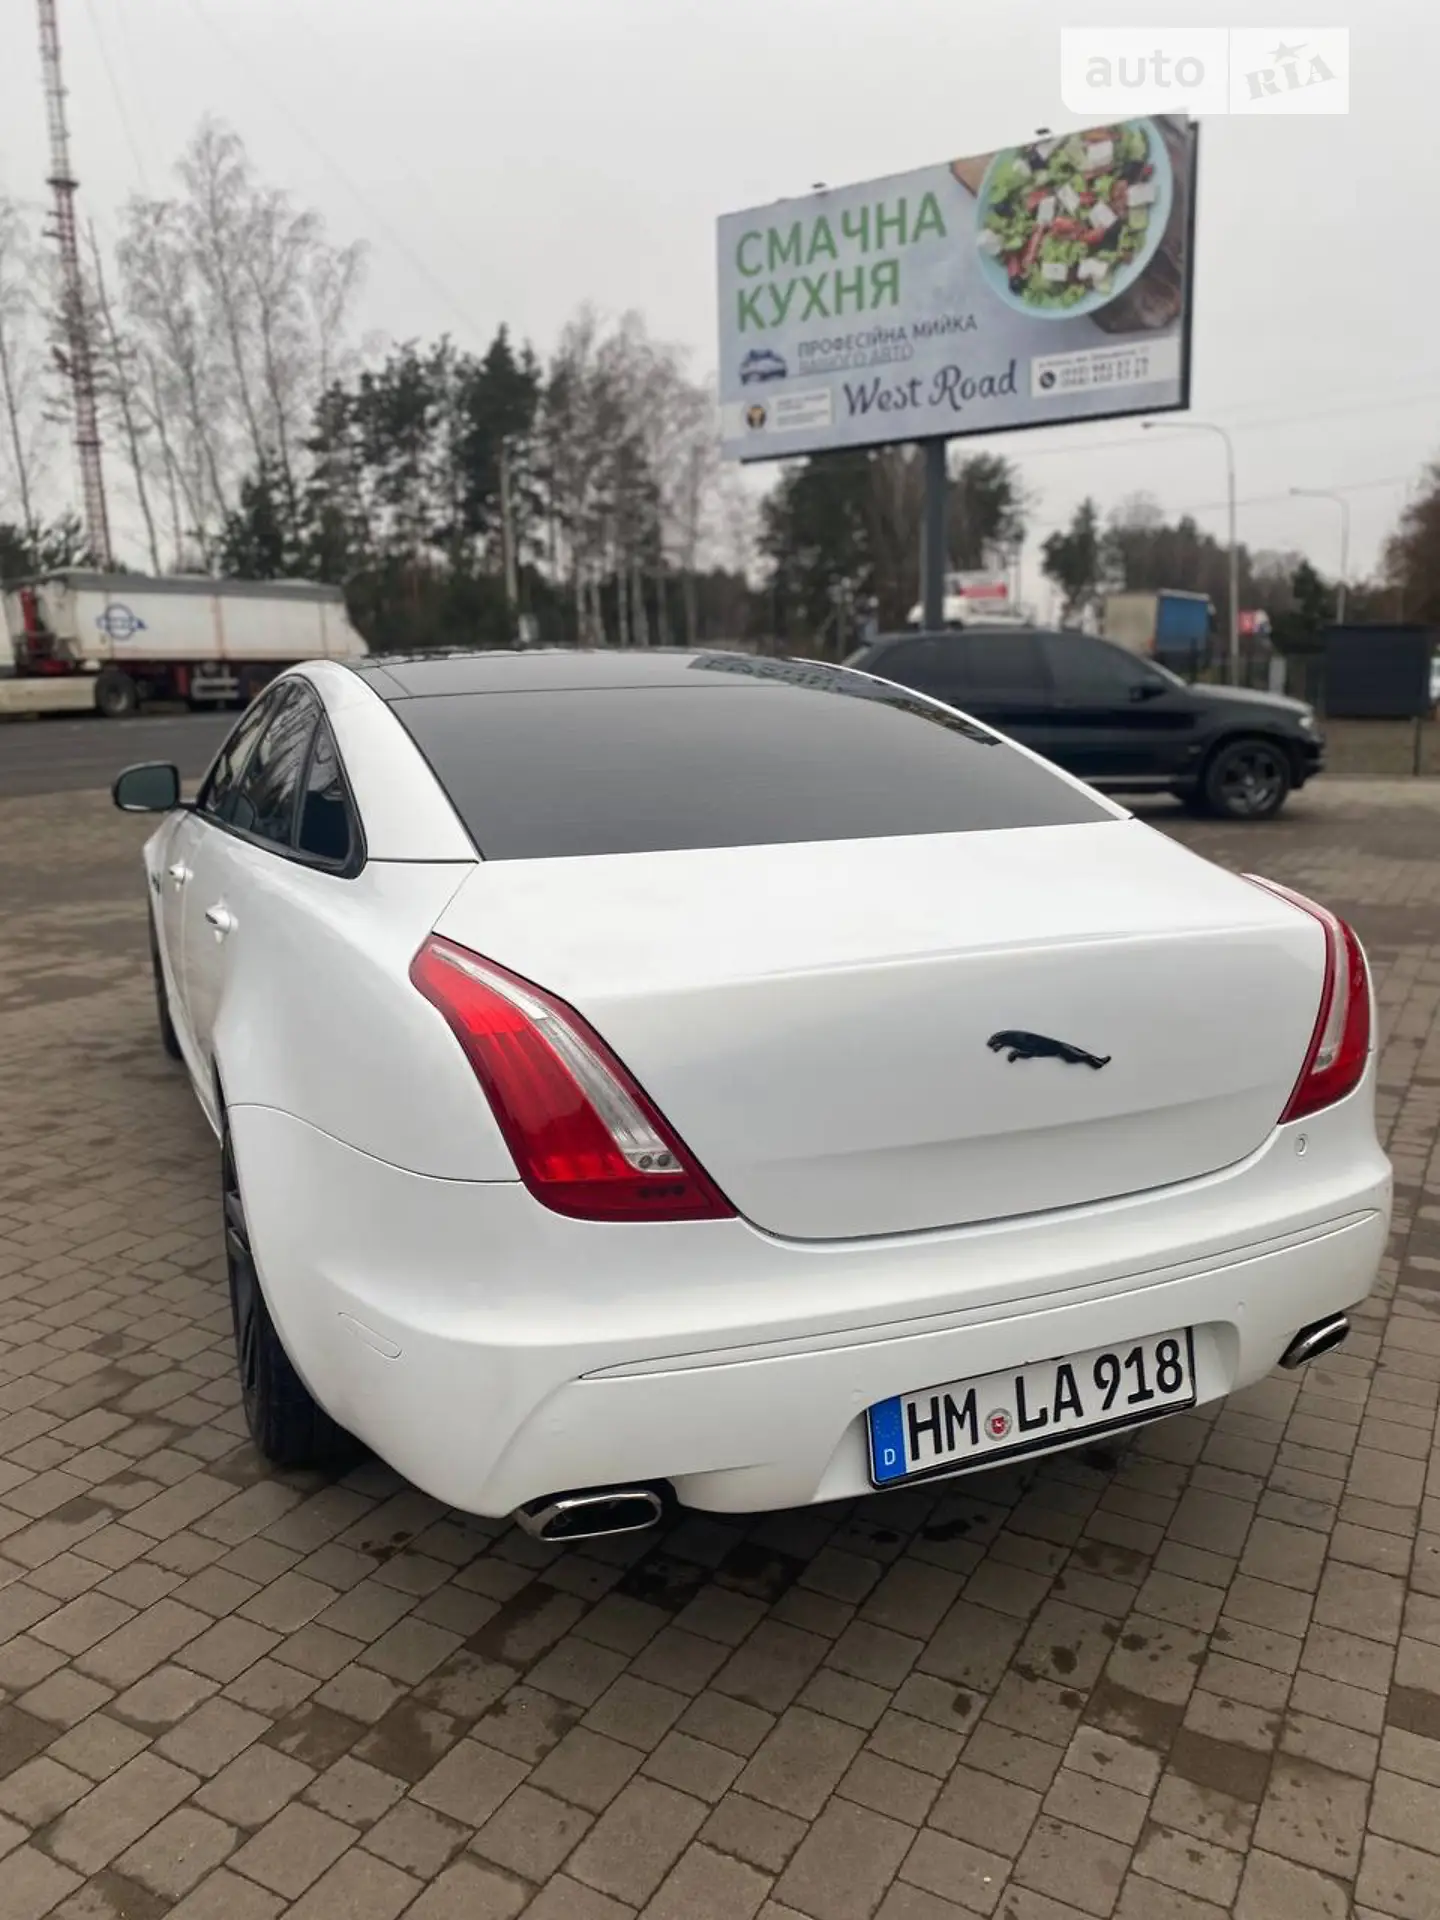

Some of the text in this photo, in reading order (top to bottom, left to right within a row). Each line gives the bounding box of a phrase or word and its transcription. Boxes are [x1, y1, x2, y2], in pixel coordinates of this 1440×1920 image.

[736, 191, 947, 278] СМАЧНА
[736, 258, 901, 333] КУХНЯ
[797, 313, 978, 358] ПРОФЕСІЙНА МИЙКА
[843, 371, 921, 417] West
[929, 360, 1018, 412] Road
[907, 1338, 1184, 1462] HM LA 918
[883, 1448, 896, 1466] D
